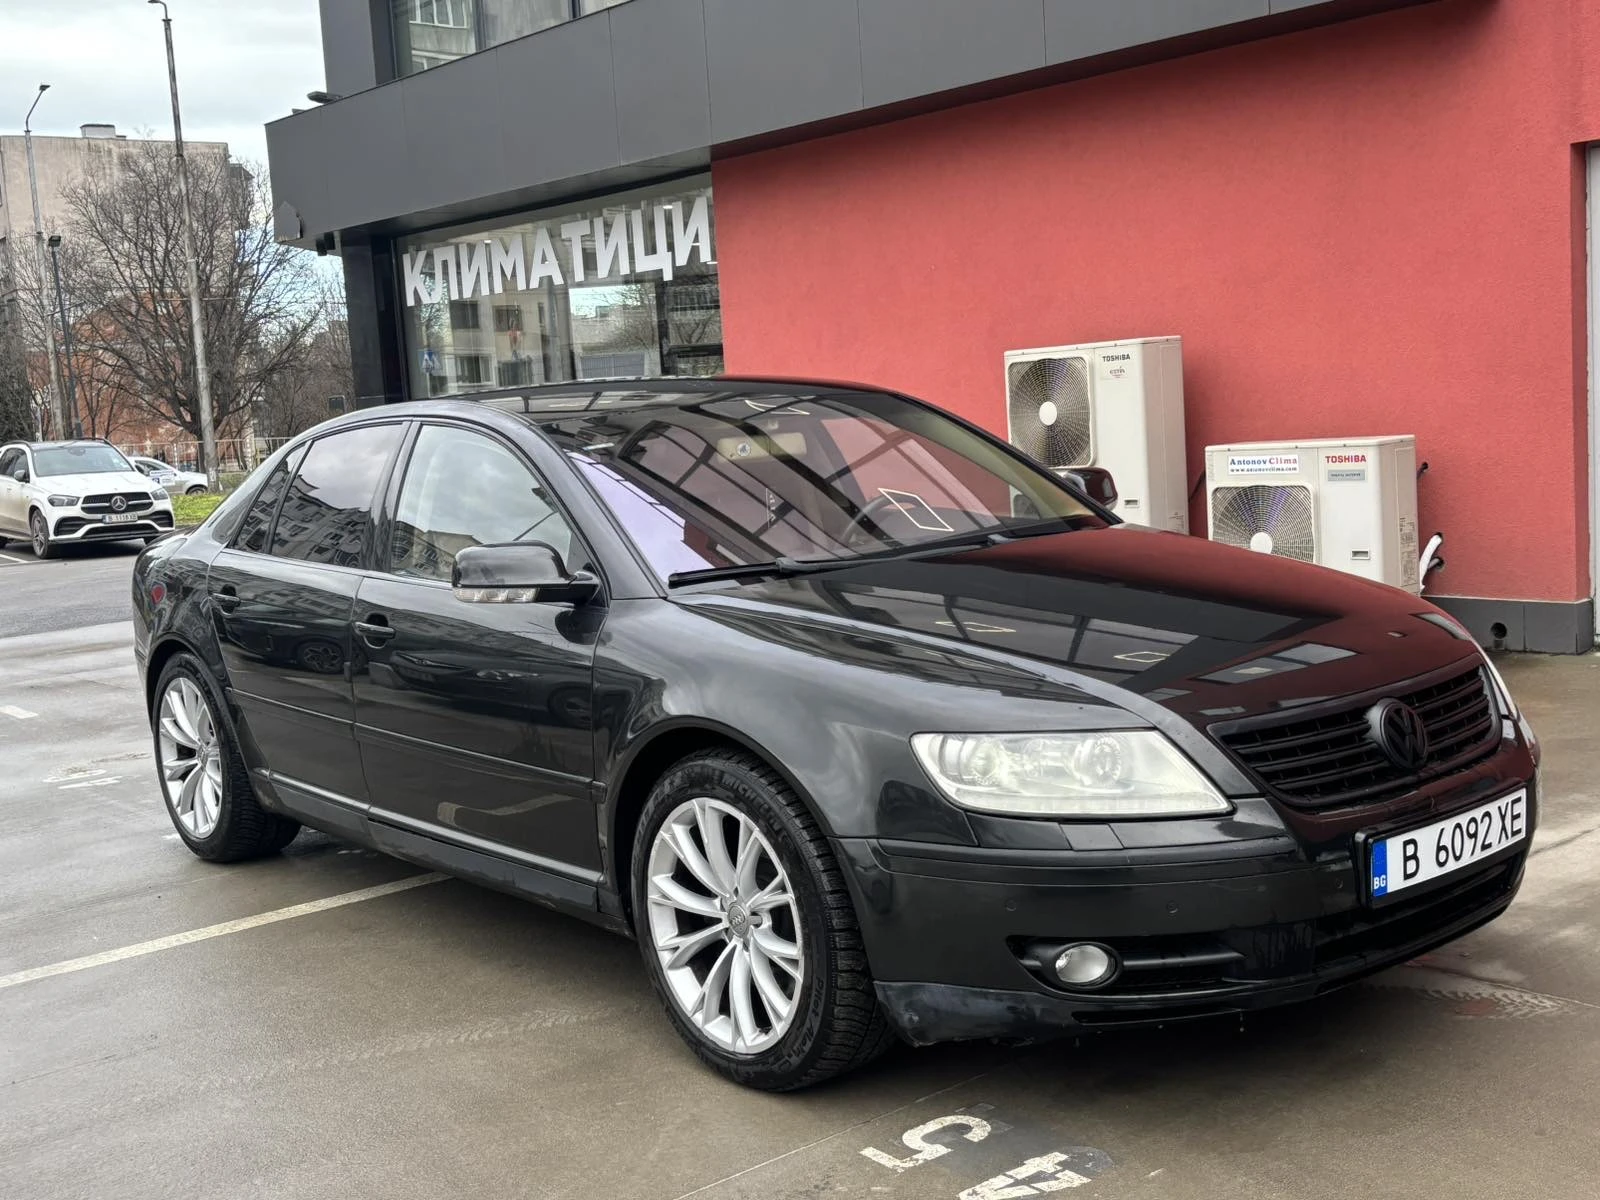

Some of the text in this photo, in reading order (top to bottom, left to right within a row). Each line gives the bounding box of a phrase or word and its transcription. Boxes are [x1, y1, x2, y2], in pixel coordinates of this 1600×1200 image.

[402, 197, 712, 307] КЛИМАТИЦИ
[1102, 353, 1130, 362] TOSHIBA
[1229, 457, 1297, 466] Antonov Clima
[1325, 455, 1367, 464] TOSHIBA
[1402, 796, 1523, 881] B 6092 XE
[1373, 874, 1387, 890] BG
